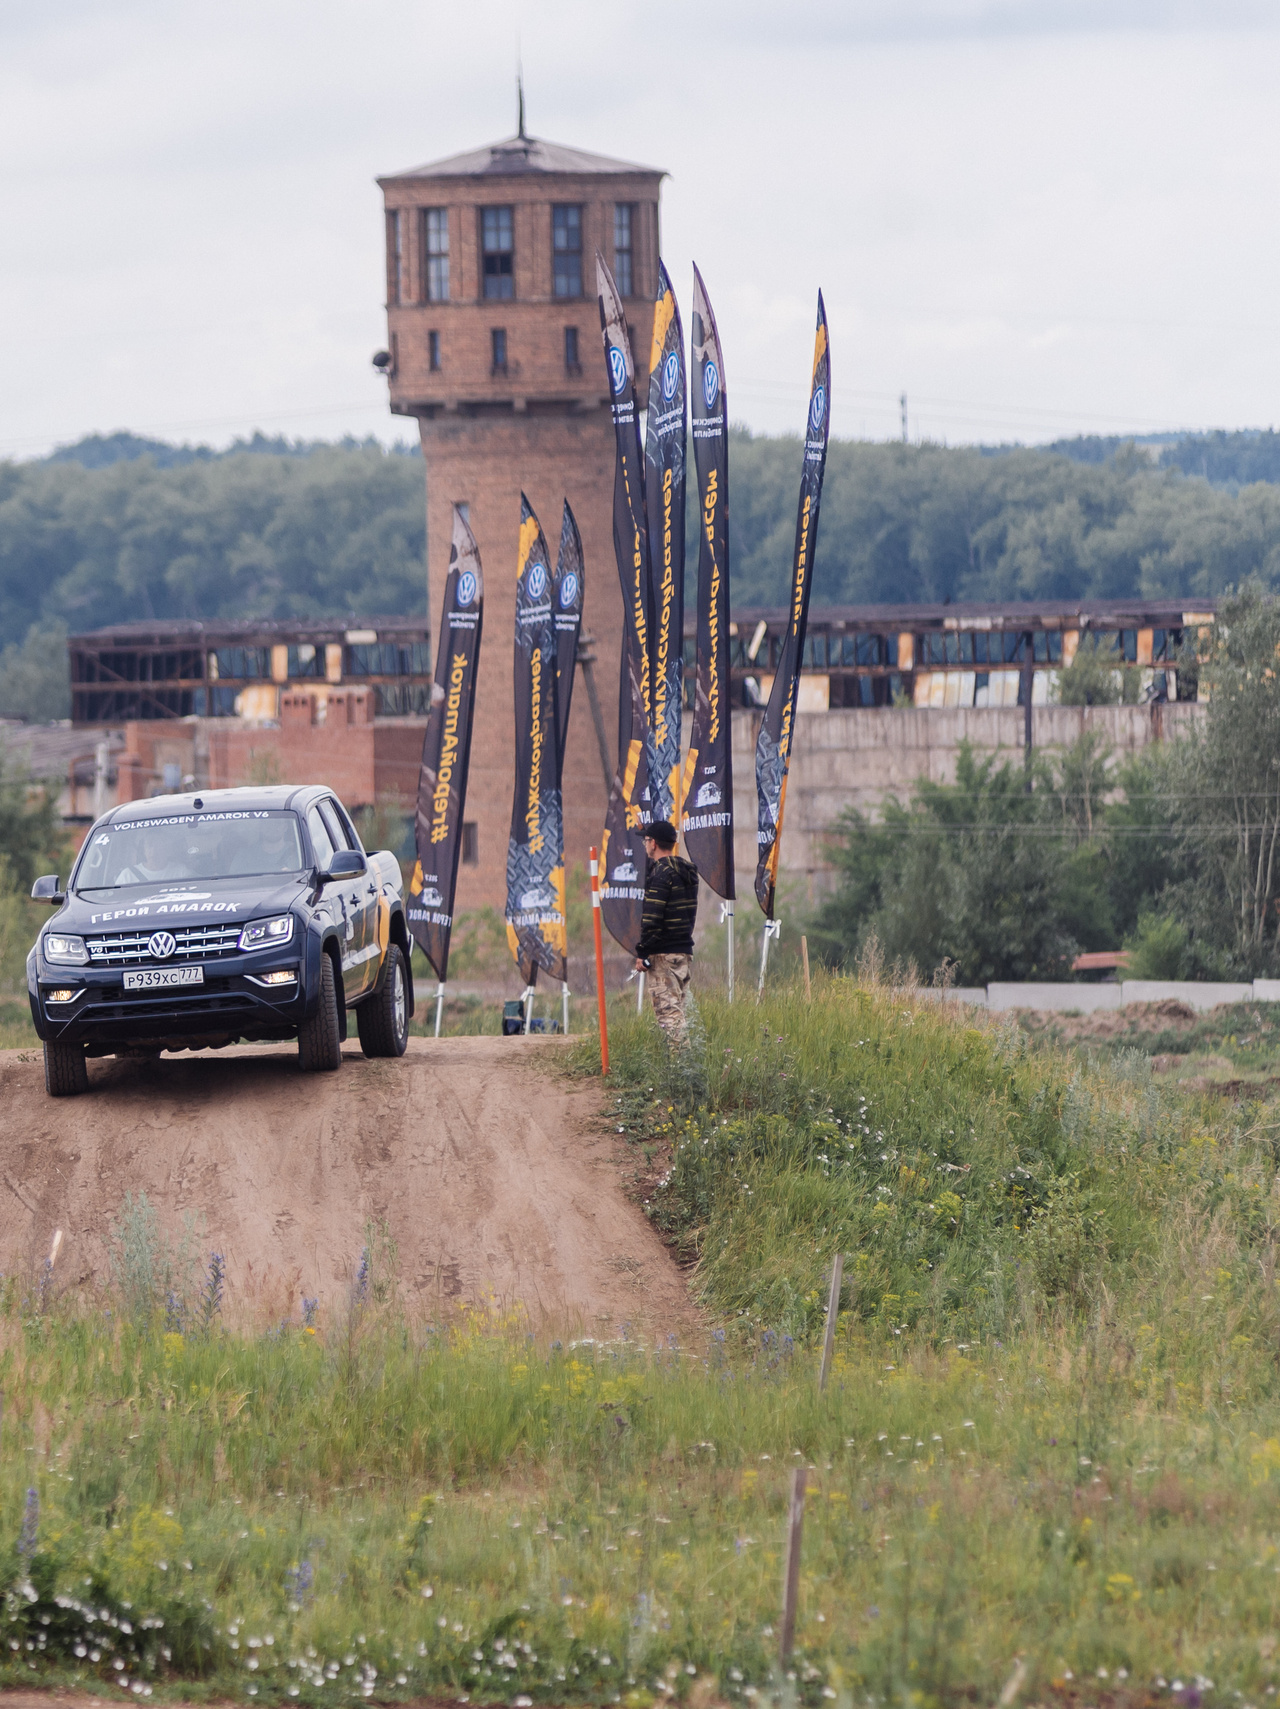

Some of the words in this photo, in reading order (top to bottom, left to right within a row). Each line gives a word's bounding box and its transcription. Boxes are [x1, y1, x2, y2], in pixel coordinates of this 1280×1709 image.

[114, 816, 195, 831] VOLKSWAGEN
[197, 812, 251, 822] AMAROK
[253, 811, 270, 819] V6
[95, 833, 110, 846] 4
[156, 902, 242, 913] AMAROK
[90, 946, 104, 955] V6
[180, 967, 199, 980] 777
